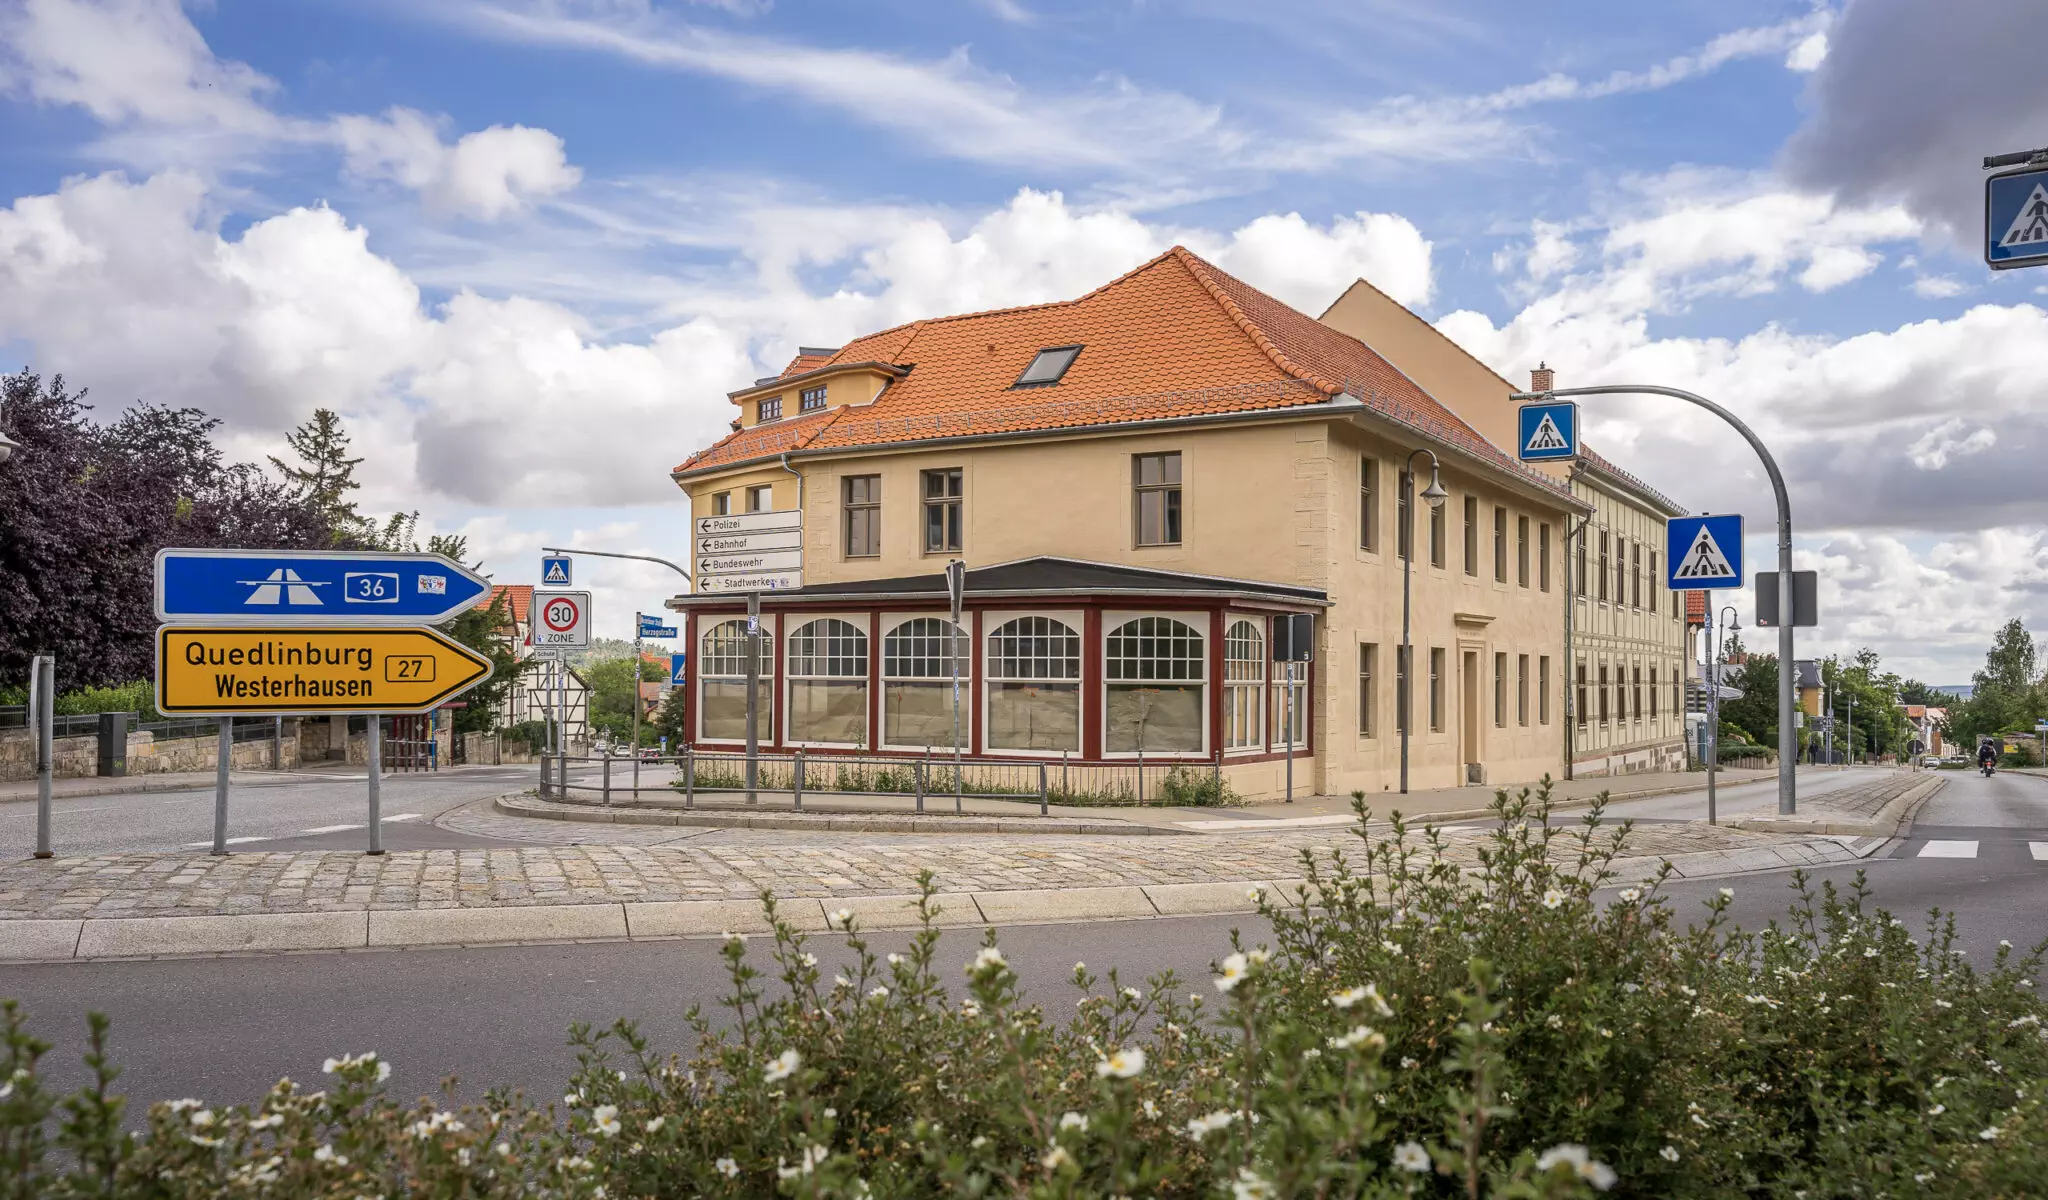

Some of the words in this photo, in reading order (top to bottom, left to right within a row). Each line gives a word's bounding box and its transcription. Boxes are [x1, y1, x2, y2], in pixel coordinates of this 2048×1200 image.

[714, 519, 740, 529] Polizei
[714, 538, 747, 549] Bahnhof
[713, 558, 763, 569] Bundeswehr
[360, 578, 385, 597] 36
[724, 577, 770, 588] Stadtwerke
[550, 606, 571, 622] 30
[547, 633, 575, 643] ZONE
[185, 641, 372, 671] Quedlinburg
[398, 660, 423, 678] 27
[215, 674, 372, 698] Westerhausen
